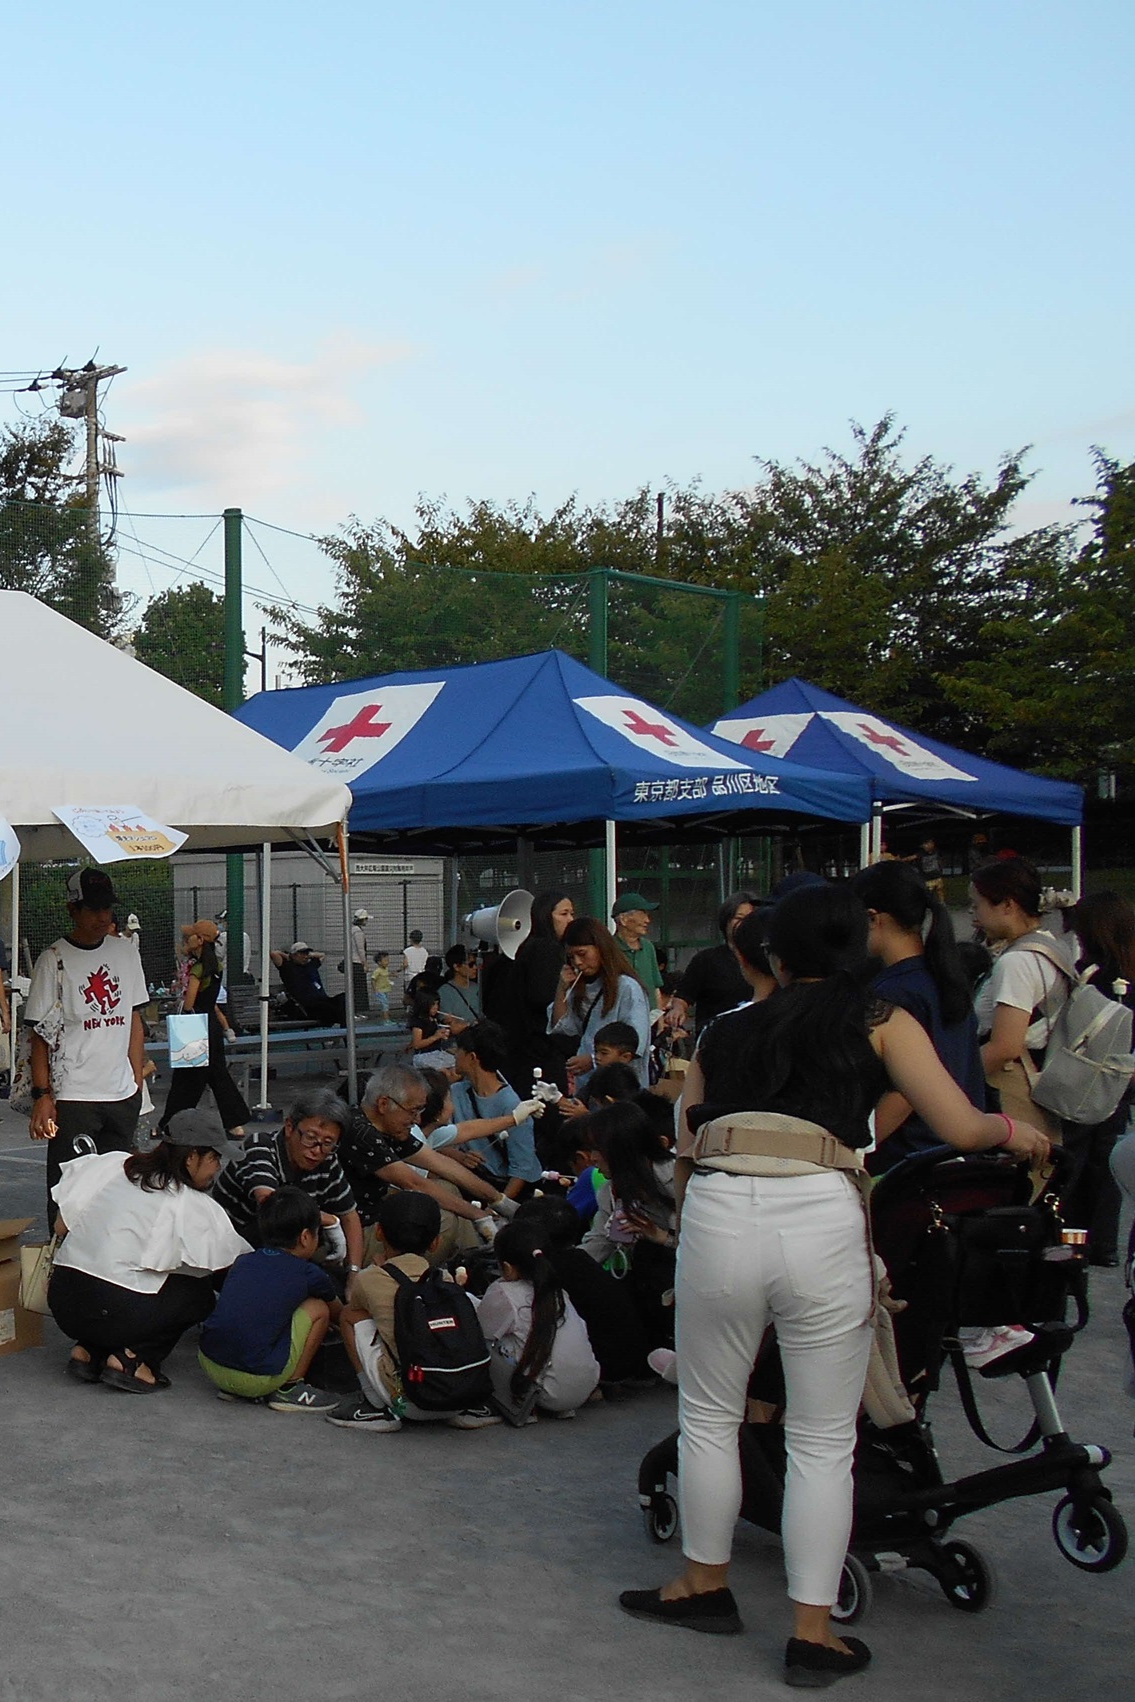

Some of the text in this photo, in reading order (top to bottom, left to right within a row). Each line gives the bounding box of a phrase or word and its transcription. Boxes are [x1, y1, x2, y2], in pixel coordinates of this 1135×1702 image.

[633, 773, 781, 803] 東京都支部 品川区地区
[104, 1016, 125, 1027] YORK
